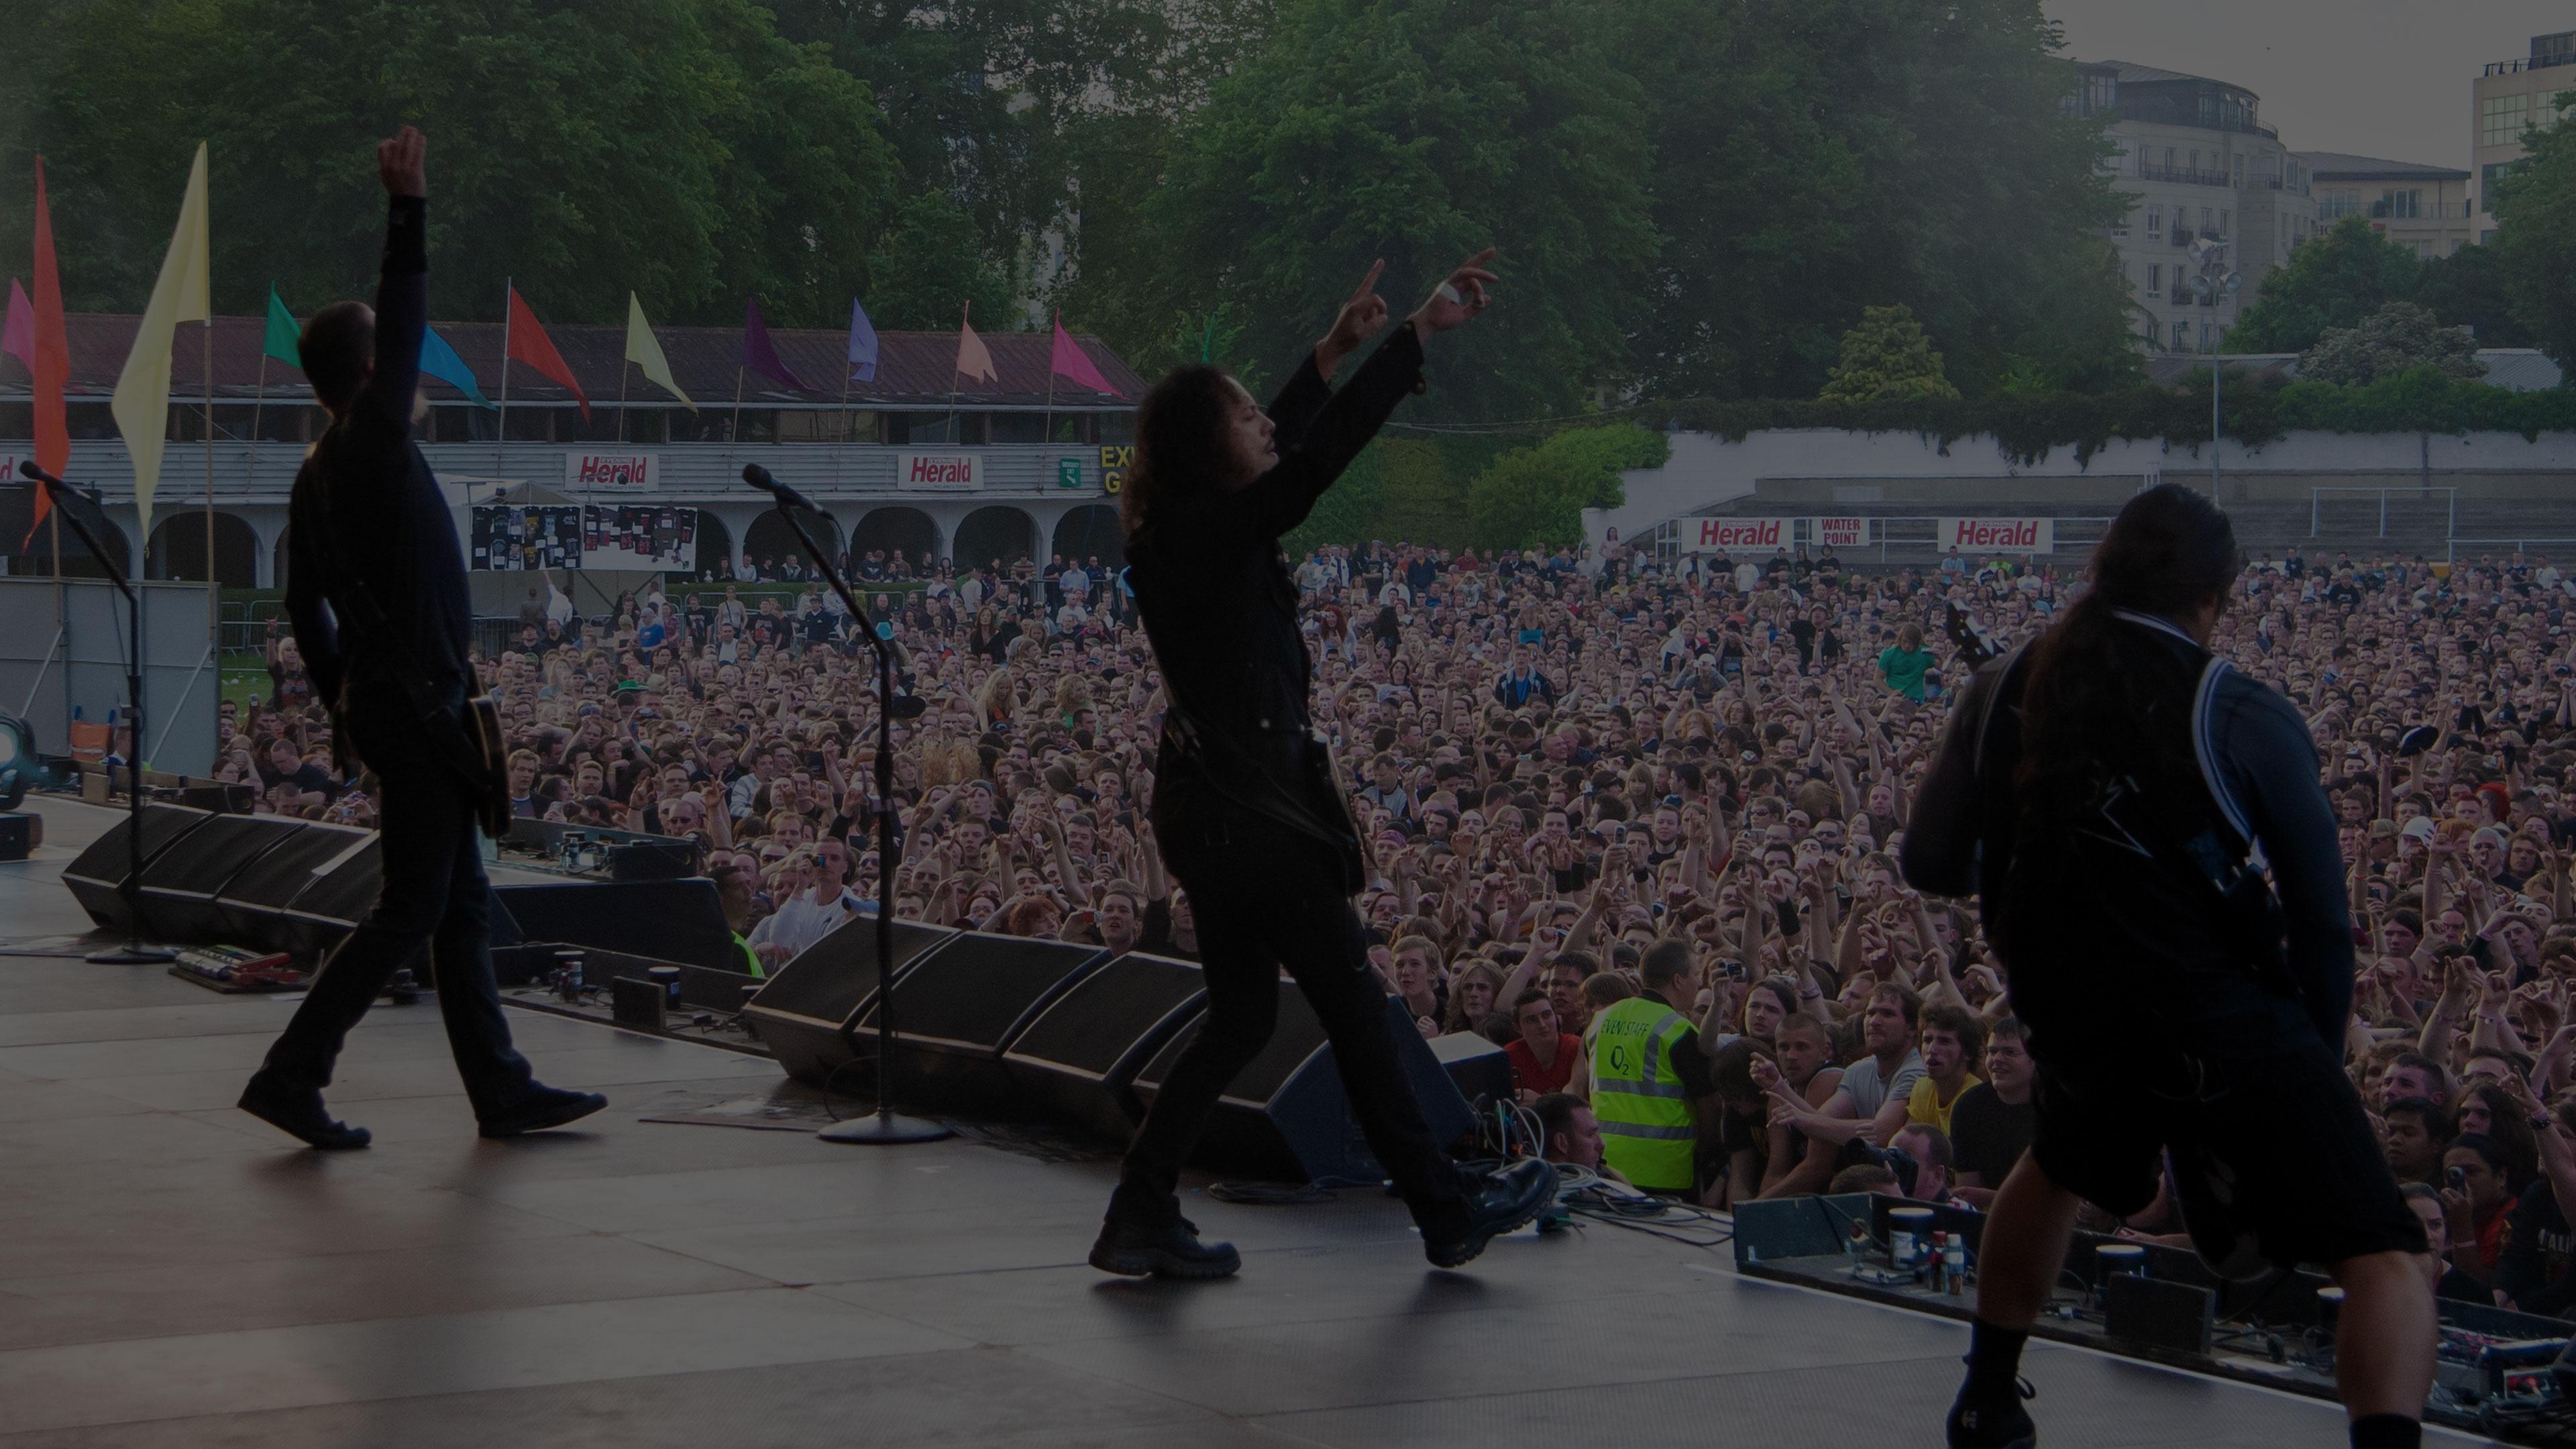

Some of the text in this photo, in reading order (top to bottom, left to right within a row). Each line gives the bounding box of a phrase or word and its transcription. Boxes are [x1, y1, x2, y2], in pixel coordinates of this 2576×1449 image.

[579, 456, 647, 483] Herald
[910, 457, 971, 482] Herald
[1700, 520, 1781, 545] Herald
[1822, 519, 1860, 530] WATER
[1956, 521, 2039, 545] Herald
[1824, 533, 1858, 544] POINT
[1601, 1019, 1650, 1037] EVENT STAFF
